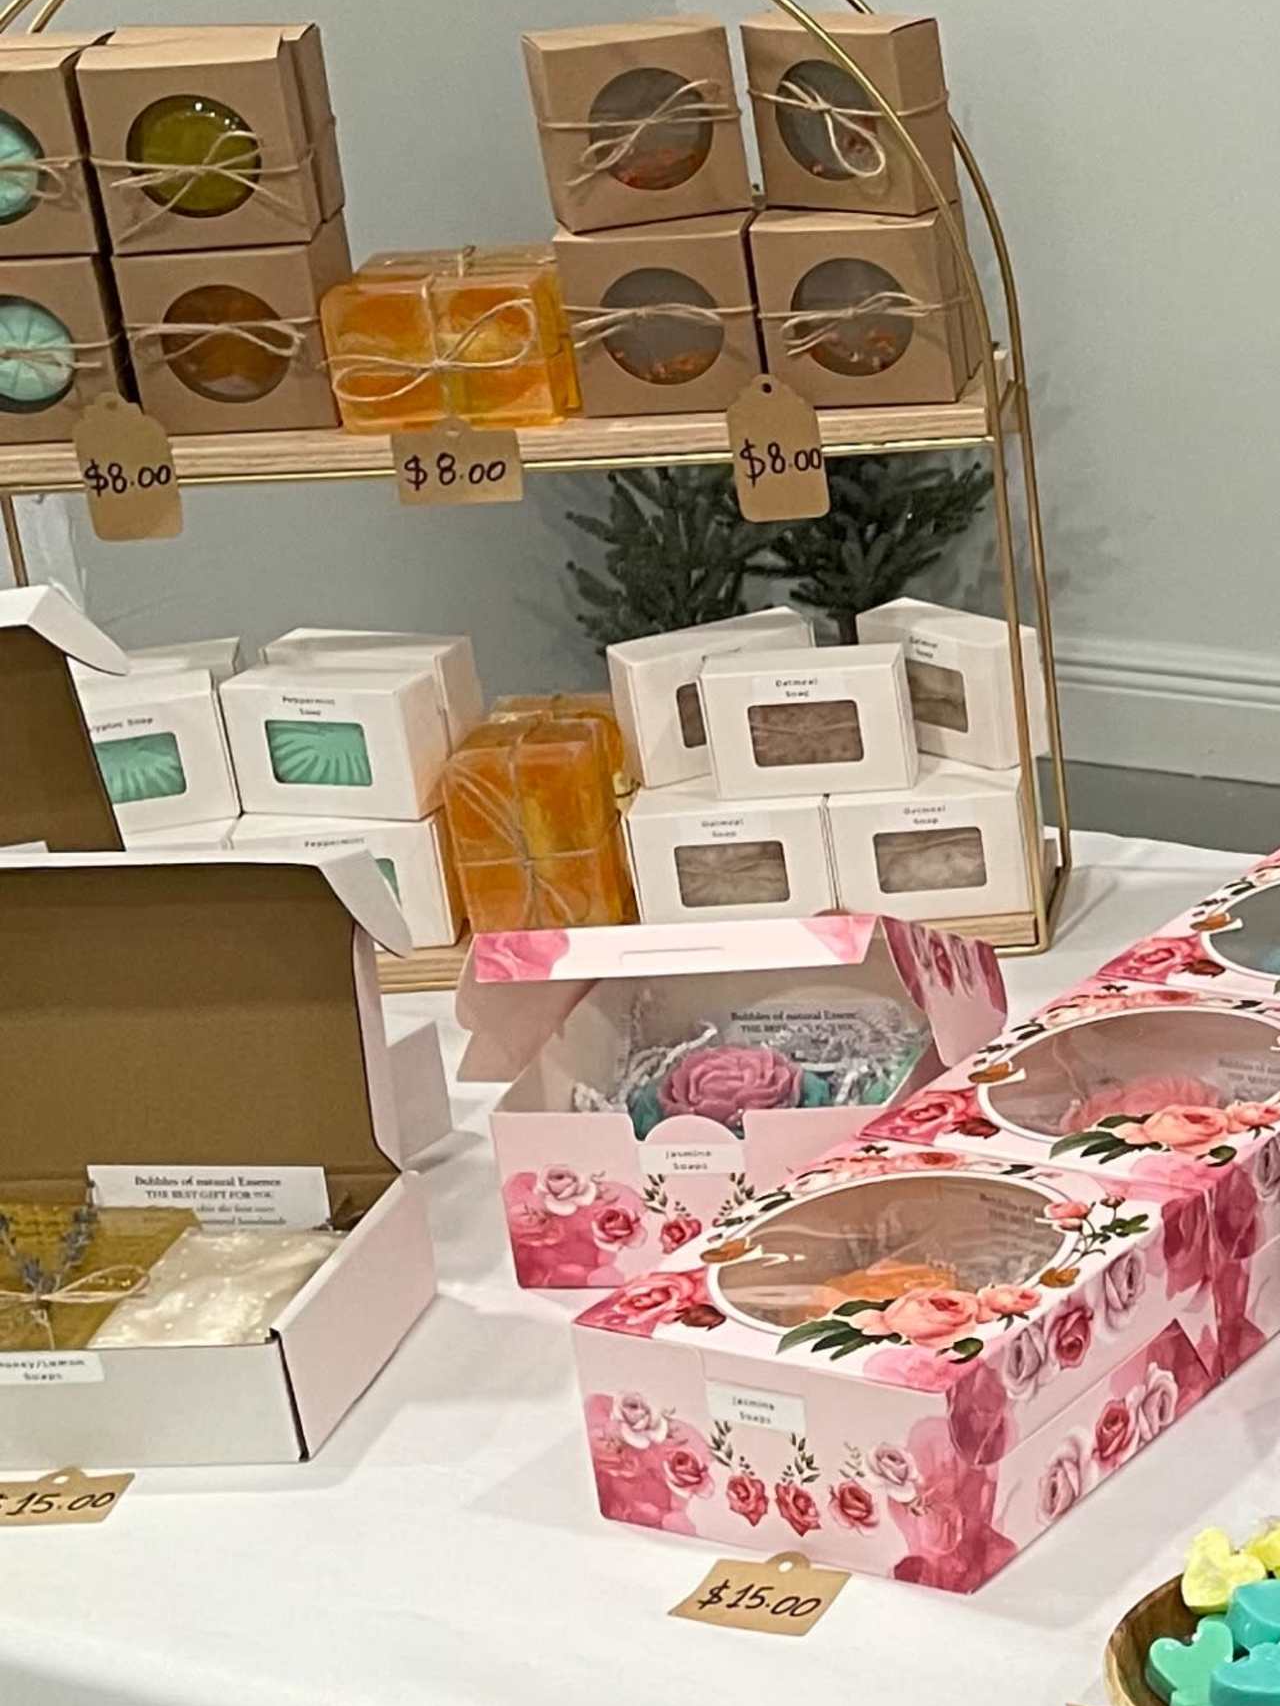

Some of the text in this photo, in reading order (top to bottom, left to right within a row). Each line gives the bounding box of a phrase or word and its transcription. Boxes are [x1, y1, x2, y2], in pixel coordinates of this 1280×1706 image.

[84, 459, 172, 497] $8.00
[404, 452, 506, 492] $8.00
[740, 438, 822, 489] $8.00
[697, 1578, 822, 1618] $15.00
